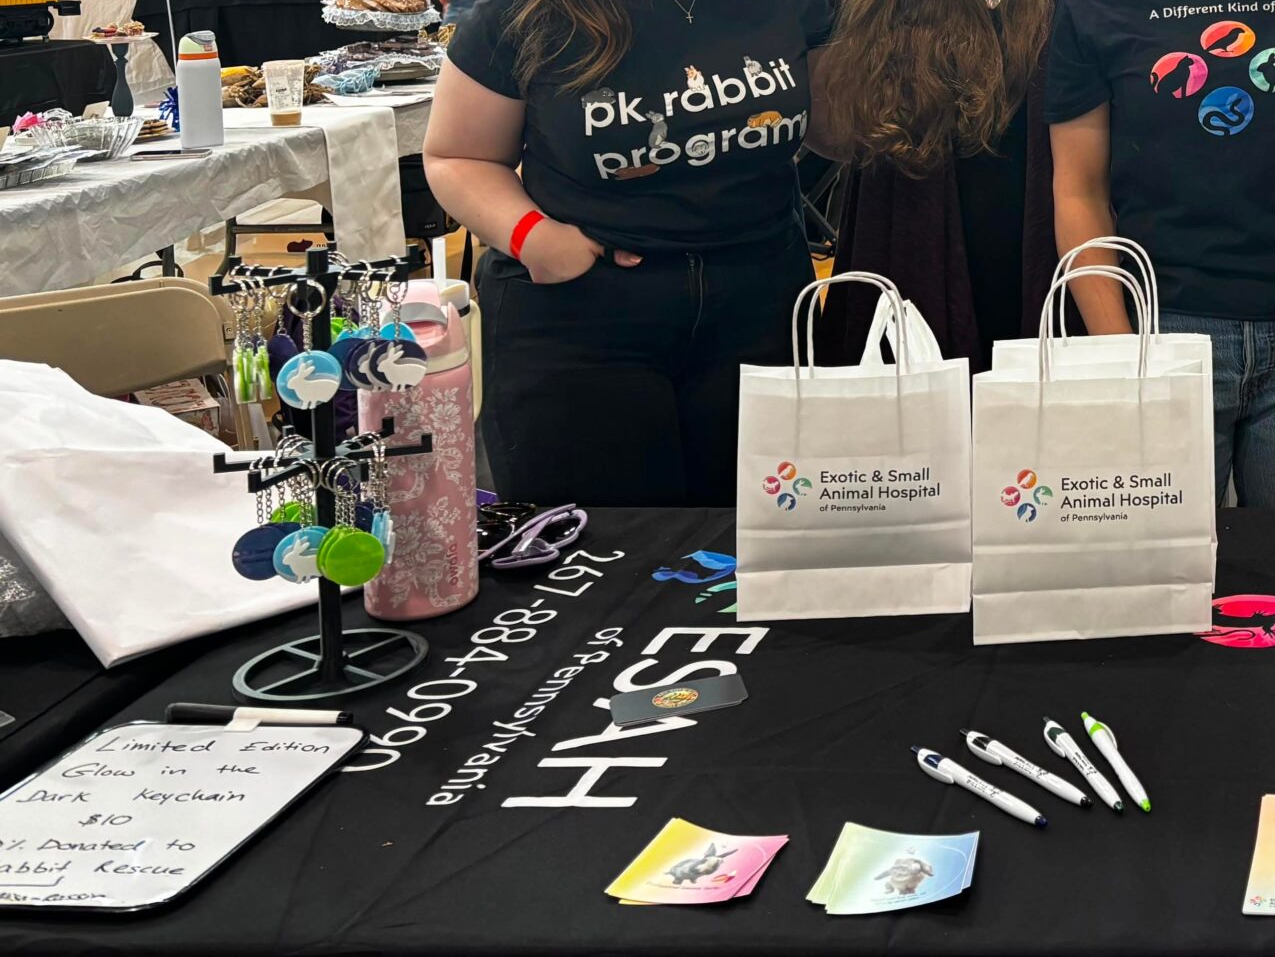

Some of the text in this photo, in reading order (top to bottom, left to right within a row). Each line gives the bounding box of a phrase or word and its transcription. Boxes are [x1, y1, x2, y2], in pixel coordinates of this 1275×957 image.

[1149, 9, 1160, 20] A
[1162, 3, 1224, 19] Different
[1228, 1, 1258, 13] Kind
[1262, 0, 1275, 13] of
[584, 57, 796, 137] pk rabbit
[593, 110, 808, 180] program
[820, 467, 930, 484] Exotic & Small
[1061, 472, 1172, 491] Exotic & Small
[819, 482, 941, 501] Animal Hospital
[1060, 490, 1183, 509] Animal Hospital
[819, 503, 886, 513] of Pennsylvania
[1060, 512, 1128, 523] of Pennsylvania
[446, 543, 459, 586] owala
[341, 549, 625, 773] 267-884-0990
[425, 627, 624, 806] of Pennsylvania
[501, 626, 770, 808] ESAH
[96, 737, 330, 754] Limited Edition
[61, 763, 261, 778] Glow in the
[16, 789, 246, 806] Dark Keychain
[78, 813, 133, 827] $10
[37, 838, 146, 852] Donated
[166, 840, 196, 852] to
[94, 860, 185, 876] Rescue
